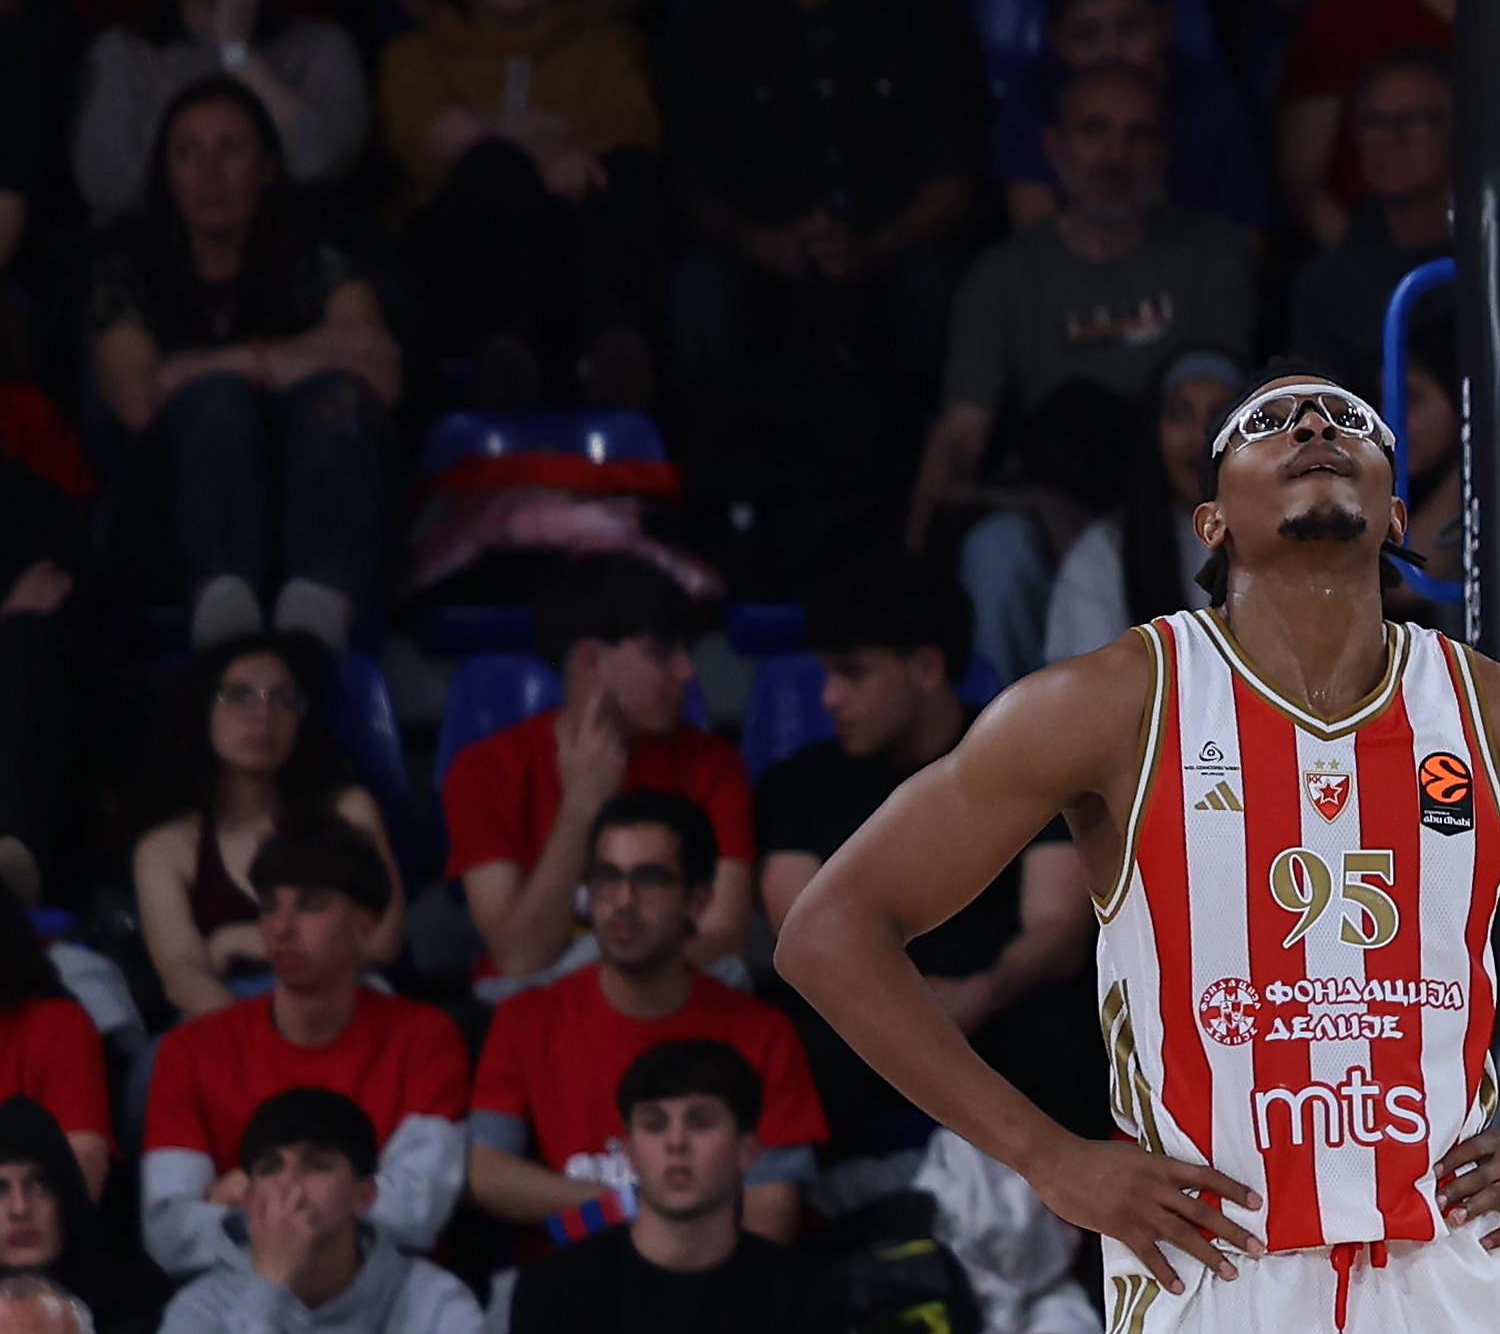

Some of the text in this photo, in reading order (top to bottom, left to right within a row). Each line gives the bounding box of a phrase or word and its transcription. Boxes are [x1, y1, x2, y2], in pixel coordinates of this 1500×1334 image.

[1423, 814, 1471, 827] abu dhabi
[1269, 847, 1399, 949] 95
[1265, 978, 1464, 1010] ФОНДАЦИЈА
[1265, 1015, 1404, 1042] ДЕЛИЈЕ
[1254, 1068, 1428, 1149] mts
